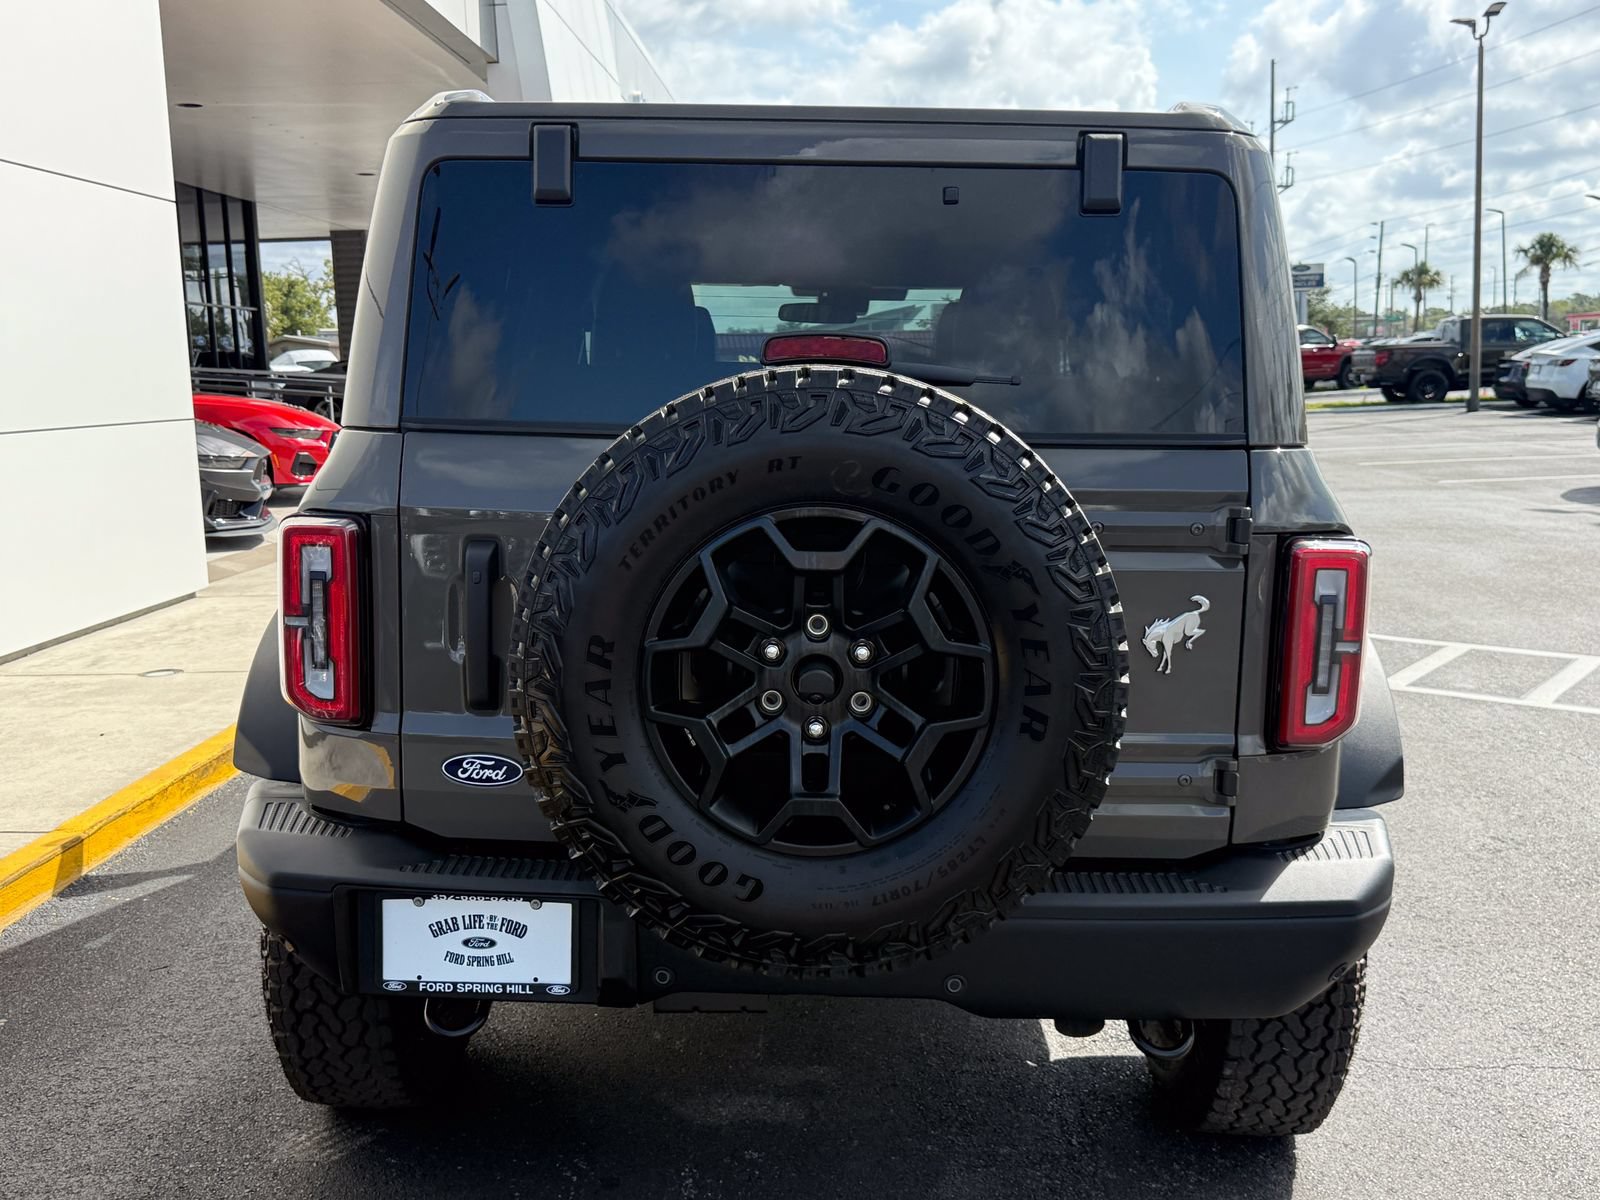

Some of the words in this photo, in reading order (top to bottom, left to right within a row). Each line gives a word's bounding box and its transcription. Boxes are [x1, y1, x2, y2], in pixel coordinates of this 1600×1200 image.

[618, 468, 740, 572] TERRITORY
[457, 758, 508, 781] Ford
[428, 916, 460, 938] GRAB
[461, 914, 485, 930] LIFE
[486, 922, 499, 931] THE
[499, 917, 528, 939] FORD
[467, 938, 491, 948] Ford
[443, 950, 466, 966] FORD
[466, 955, 496, 968] SPRING
[495, 952, 515, 966] HILL
[419, 982, 454, 992] FORD
[456, 983, 504, 994] SPRING
[506, 984, 534, 994] HILL
